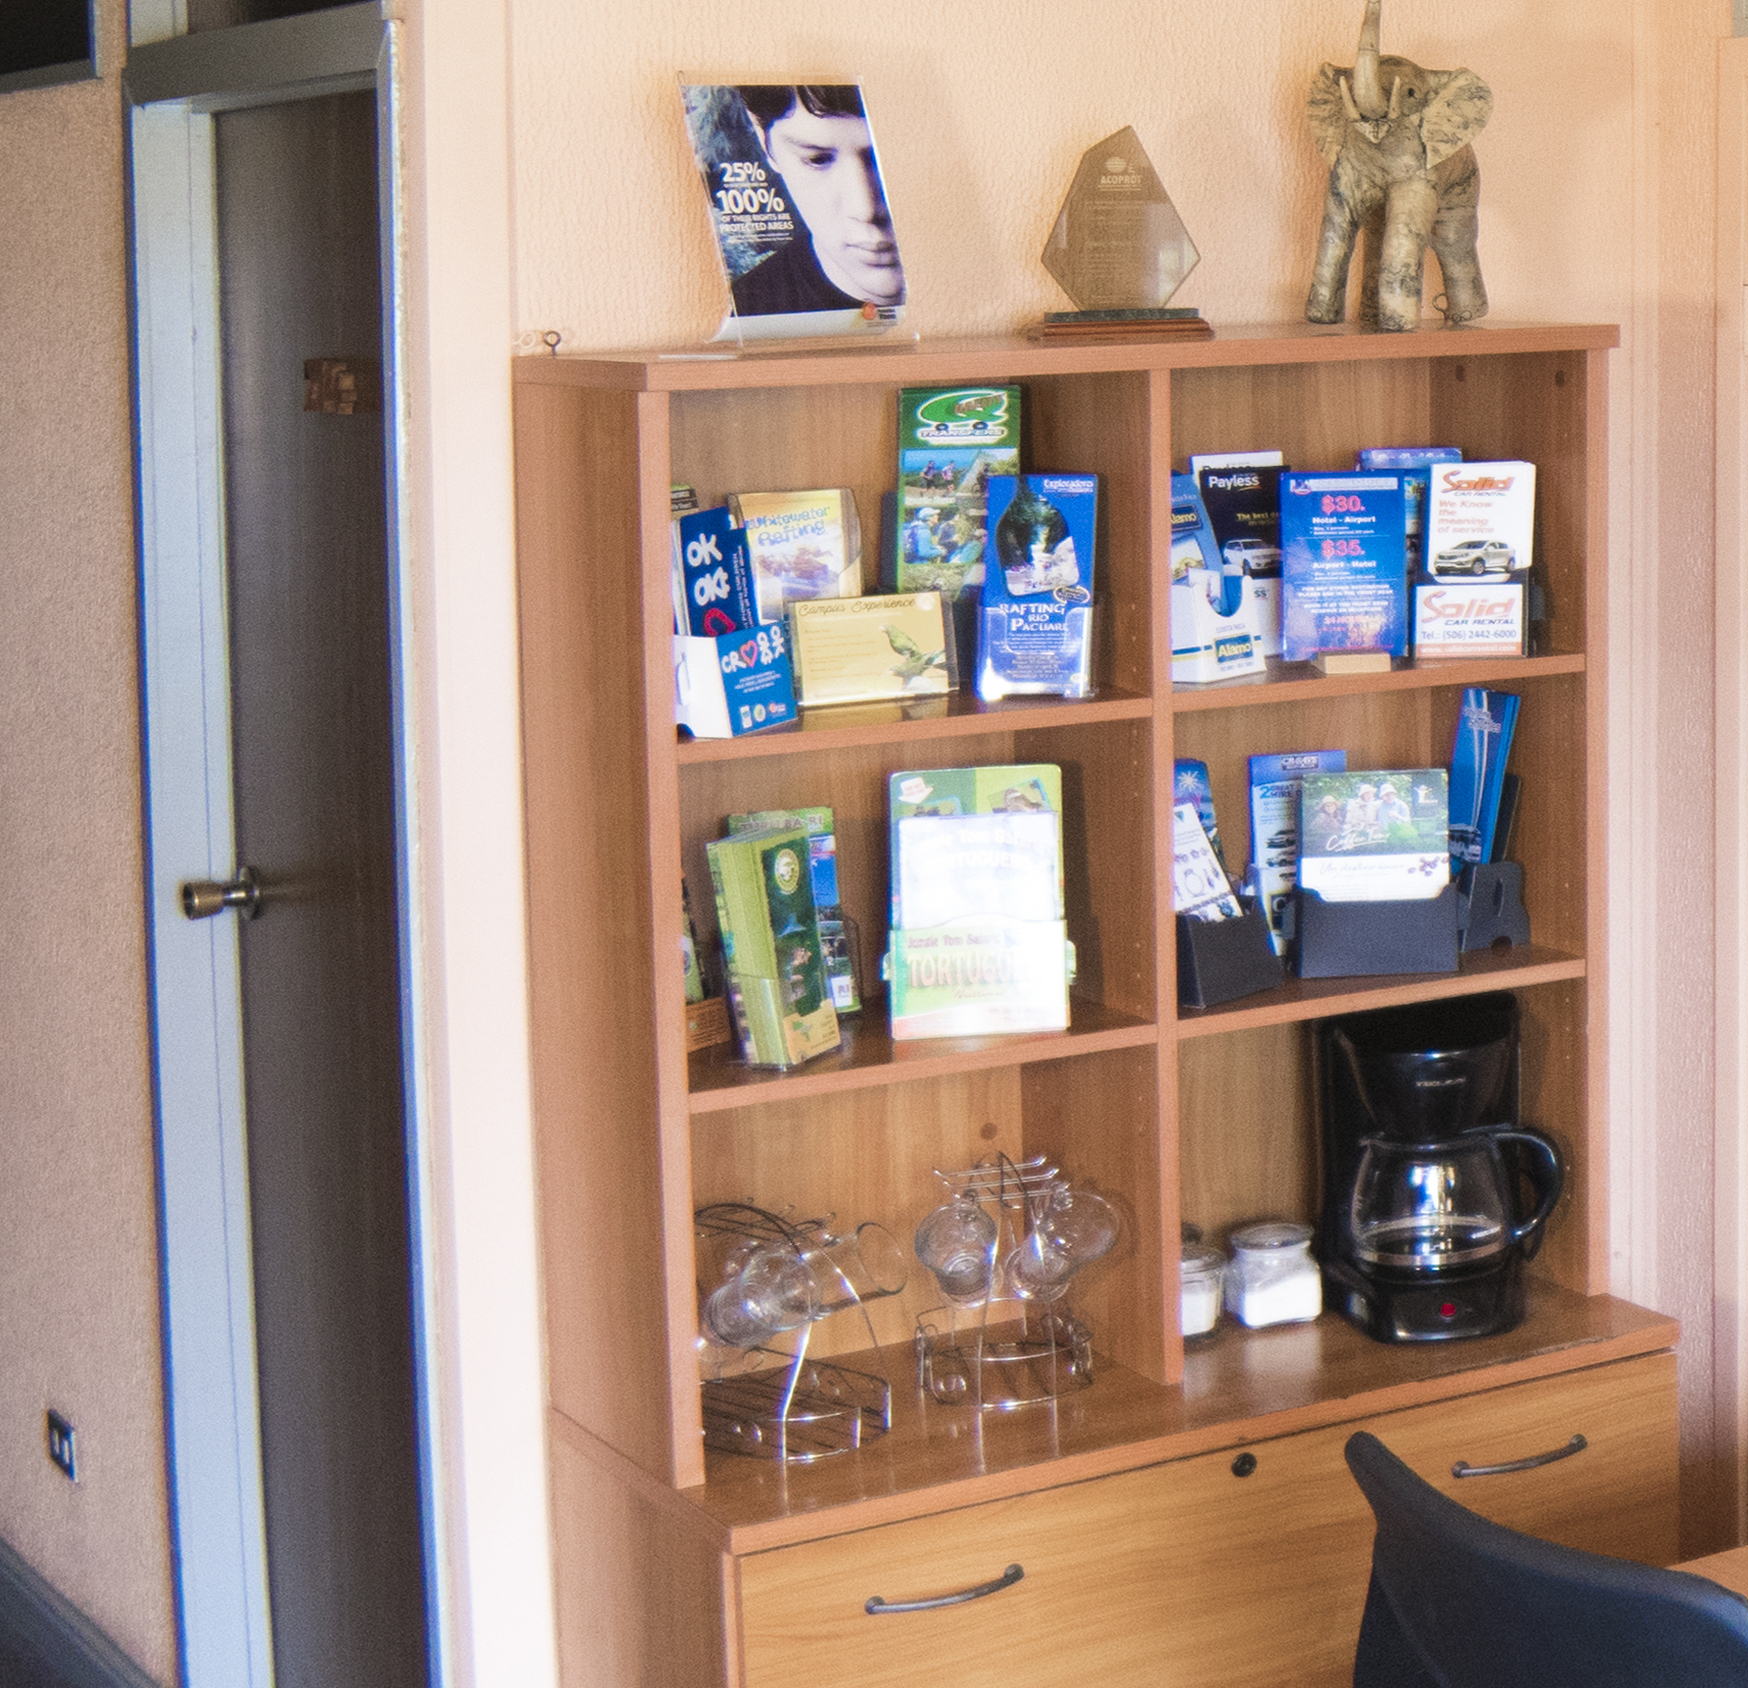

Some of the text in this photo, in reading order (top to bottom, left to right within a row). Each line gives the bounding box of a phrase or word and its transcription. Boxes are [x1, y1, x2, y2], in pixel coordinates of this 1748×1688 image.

[720, 162, 766, 182] 25%
[716, 188, 785, 214] 100%
[768, 221, 794, 230] AREAS
[1208, 474, 1260, 491] Payless
[1321, 494, 1366, 516] $30.
[1459, 500, 1494, 508] Know
[1312, 516, 1376, 524] Hotel Airport
[1438, 518, 1489, 526] meaning
[758, 519, 826, 547] Rafting
[1452, 526, 1495, 534] service
[1321, 539, 1366, 559] $35.
[1312, 560, 1376, 570] Airport Hotel
[799, 596, 916, 618] Campus Experience
[1000, 603, 1066, 615] RAFTING
[1421, 591, 1516, 624] Solid
[1028, 613, 1049, 622] RIO
[1442, 630, 1467, 640] (506)
[1468, 629, 1517, 639] 2442-6000
[1219, 643, 1251, 657] Alamo
[1260, 786, 1271, 799] 2
[1326, 828, 1367, 852] Coffee
[907, 935, 939, 949] Jungle
[943, 933, 963, 946] Tom
